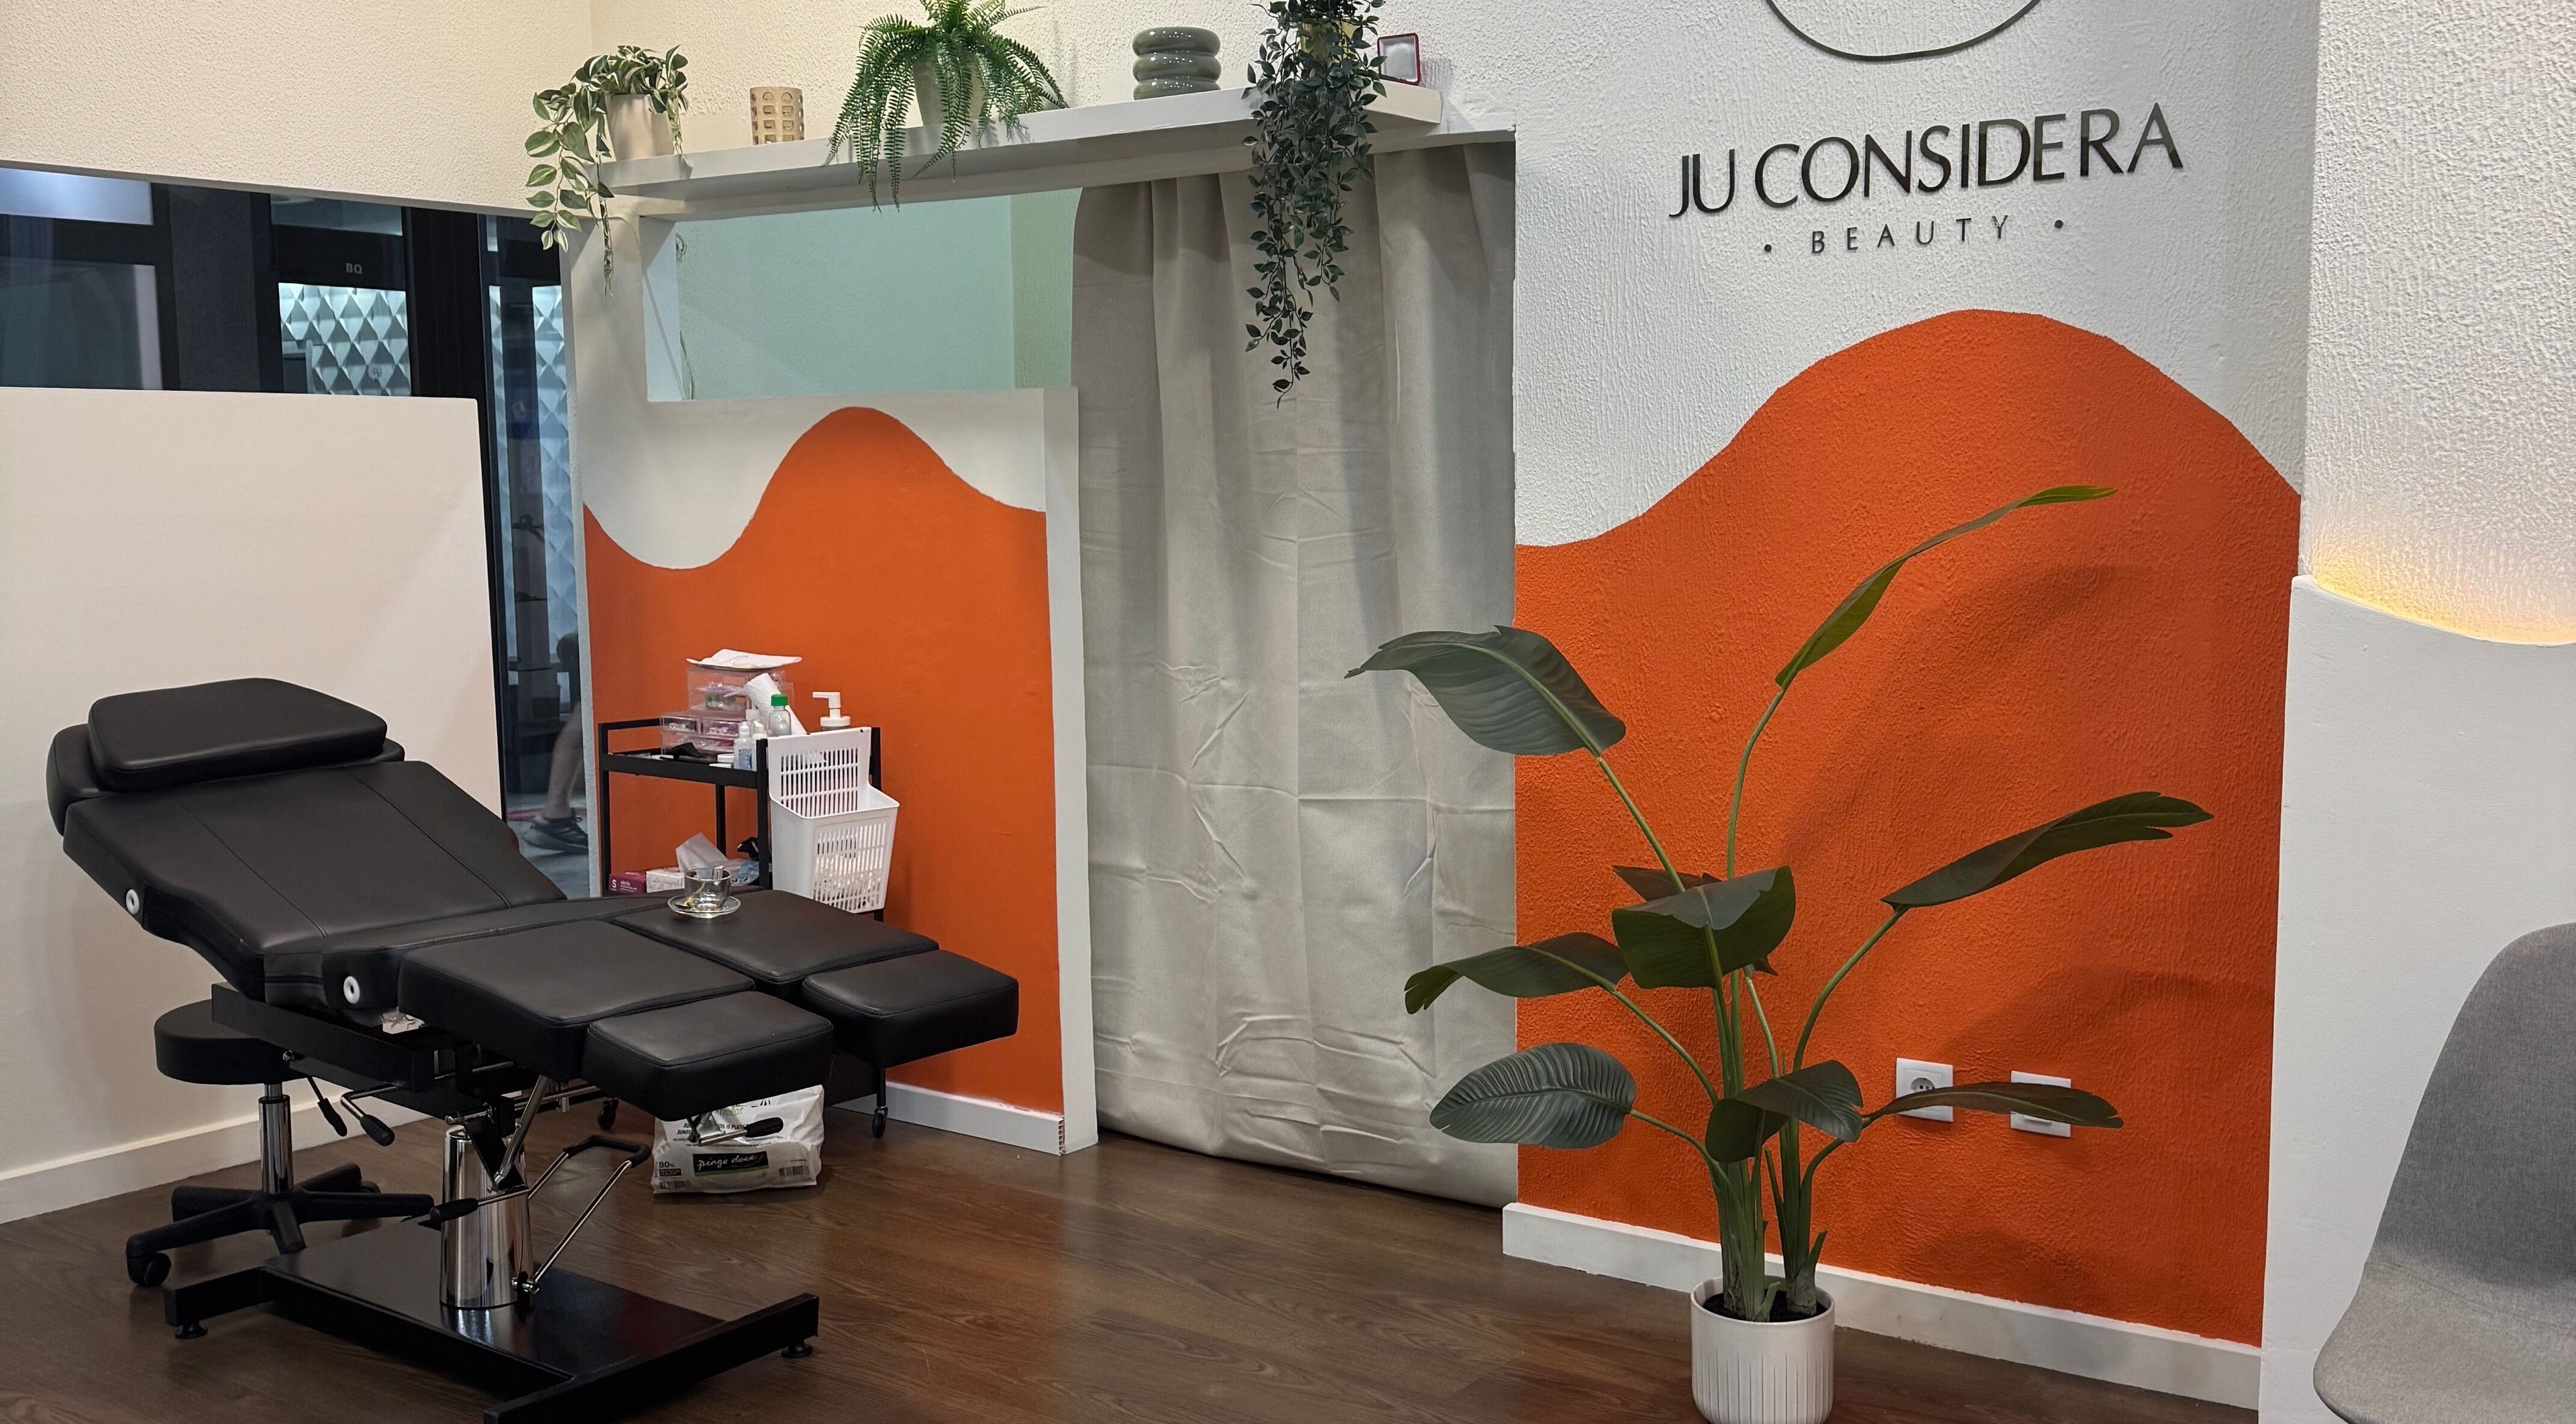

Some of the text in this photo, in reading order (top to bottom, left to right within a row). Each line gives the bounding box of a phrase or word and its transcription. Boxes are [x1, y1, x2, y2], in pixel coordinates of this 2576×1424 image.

[1668, 102, 2184, 218] JU CONSIDERA
[1811, 214, 2010, 255] BEAUTY
[345, 262, 363, 274] BQ
[612, 879, 617, 888] S
[697, 1154, 757, 1171] pingo doce
